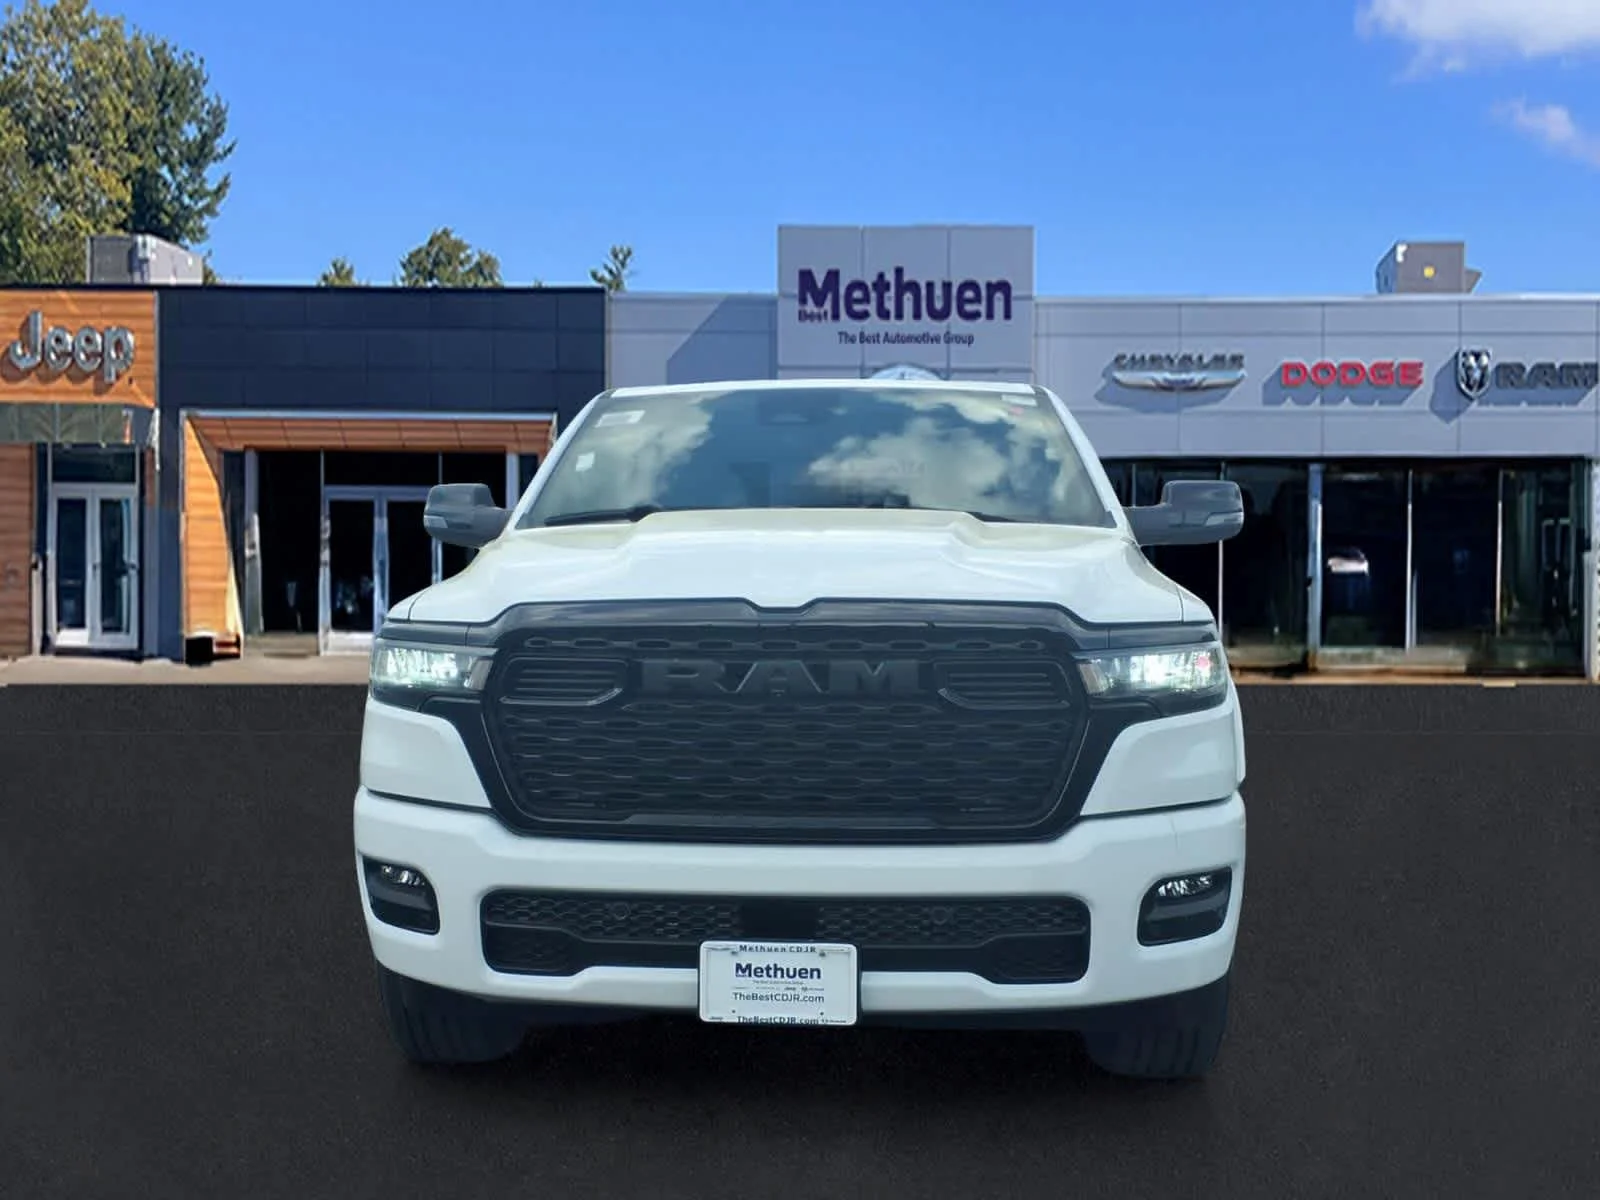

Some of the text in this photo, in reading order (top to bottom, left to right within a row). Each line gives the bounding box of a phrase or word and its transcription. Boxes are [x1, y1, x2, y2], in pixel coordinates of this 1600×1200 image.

[797, 265, 1012, 322] Methuen
[9, 310, 135, 384] Jeep
[838, 331, 974, 347] The Best Automotive Group
[1281, 360, 1424, 387] DODGE
[1495, 362, 1599, 389] RAM
[641, 659, 920, 694] RAM
[739, 945, 816, 953] Methuen CDJR
[735, 962, 821, 980] Methuen
[733, 992, 825, 1003] TheBestCDJR.com
